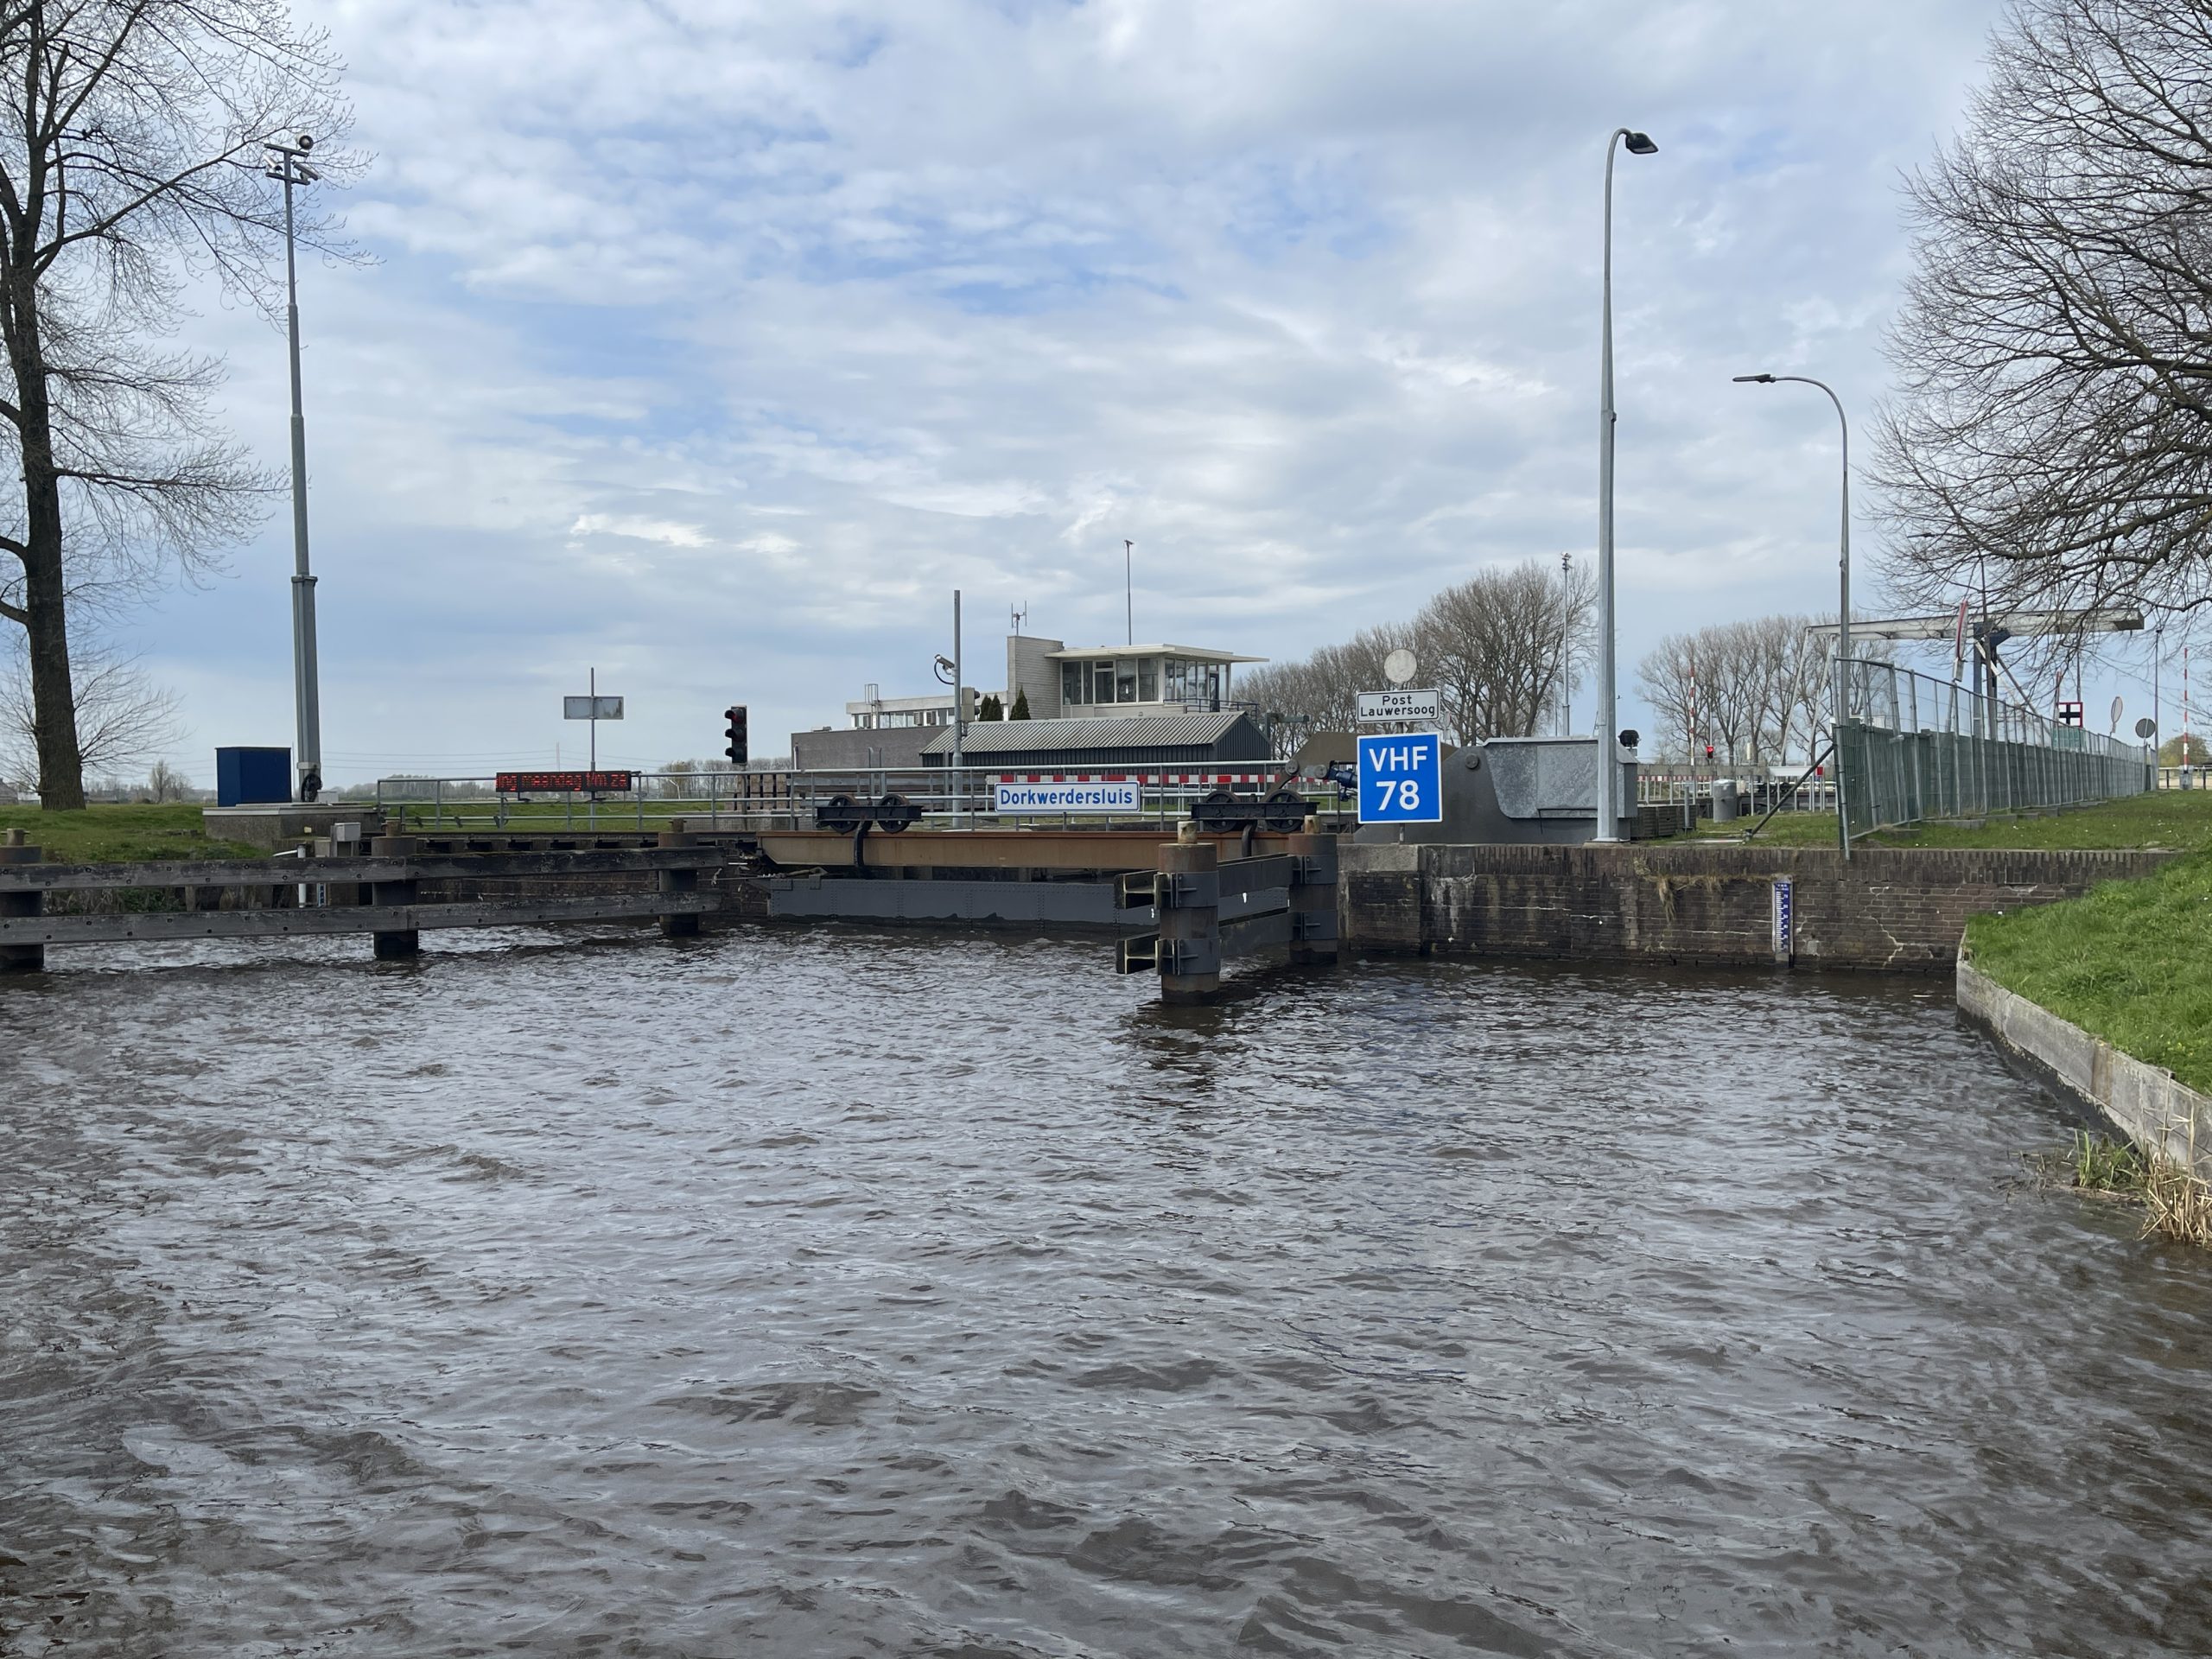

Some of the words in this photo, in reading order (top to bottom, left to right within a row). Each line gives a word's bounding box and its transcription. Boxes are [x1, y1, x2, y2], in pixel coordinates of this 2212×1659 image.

[1382, 695, 1412, 705] Post
[1360, 706, 1435, 717] Lauwersoog
[1369, 746, 1428, 772] VHF
[1000, 788, 1133, 804] Dorkwerdersluis
[1376, 779, 1420, 810] 78
